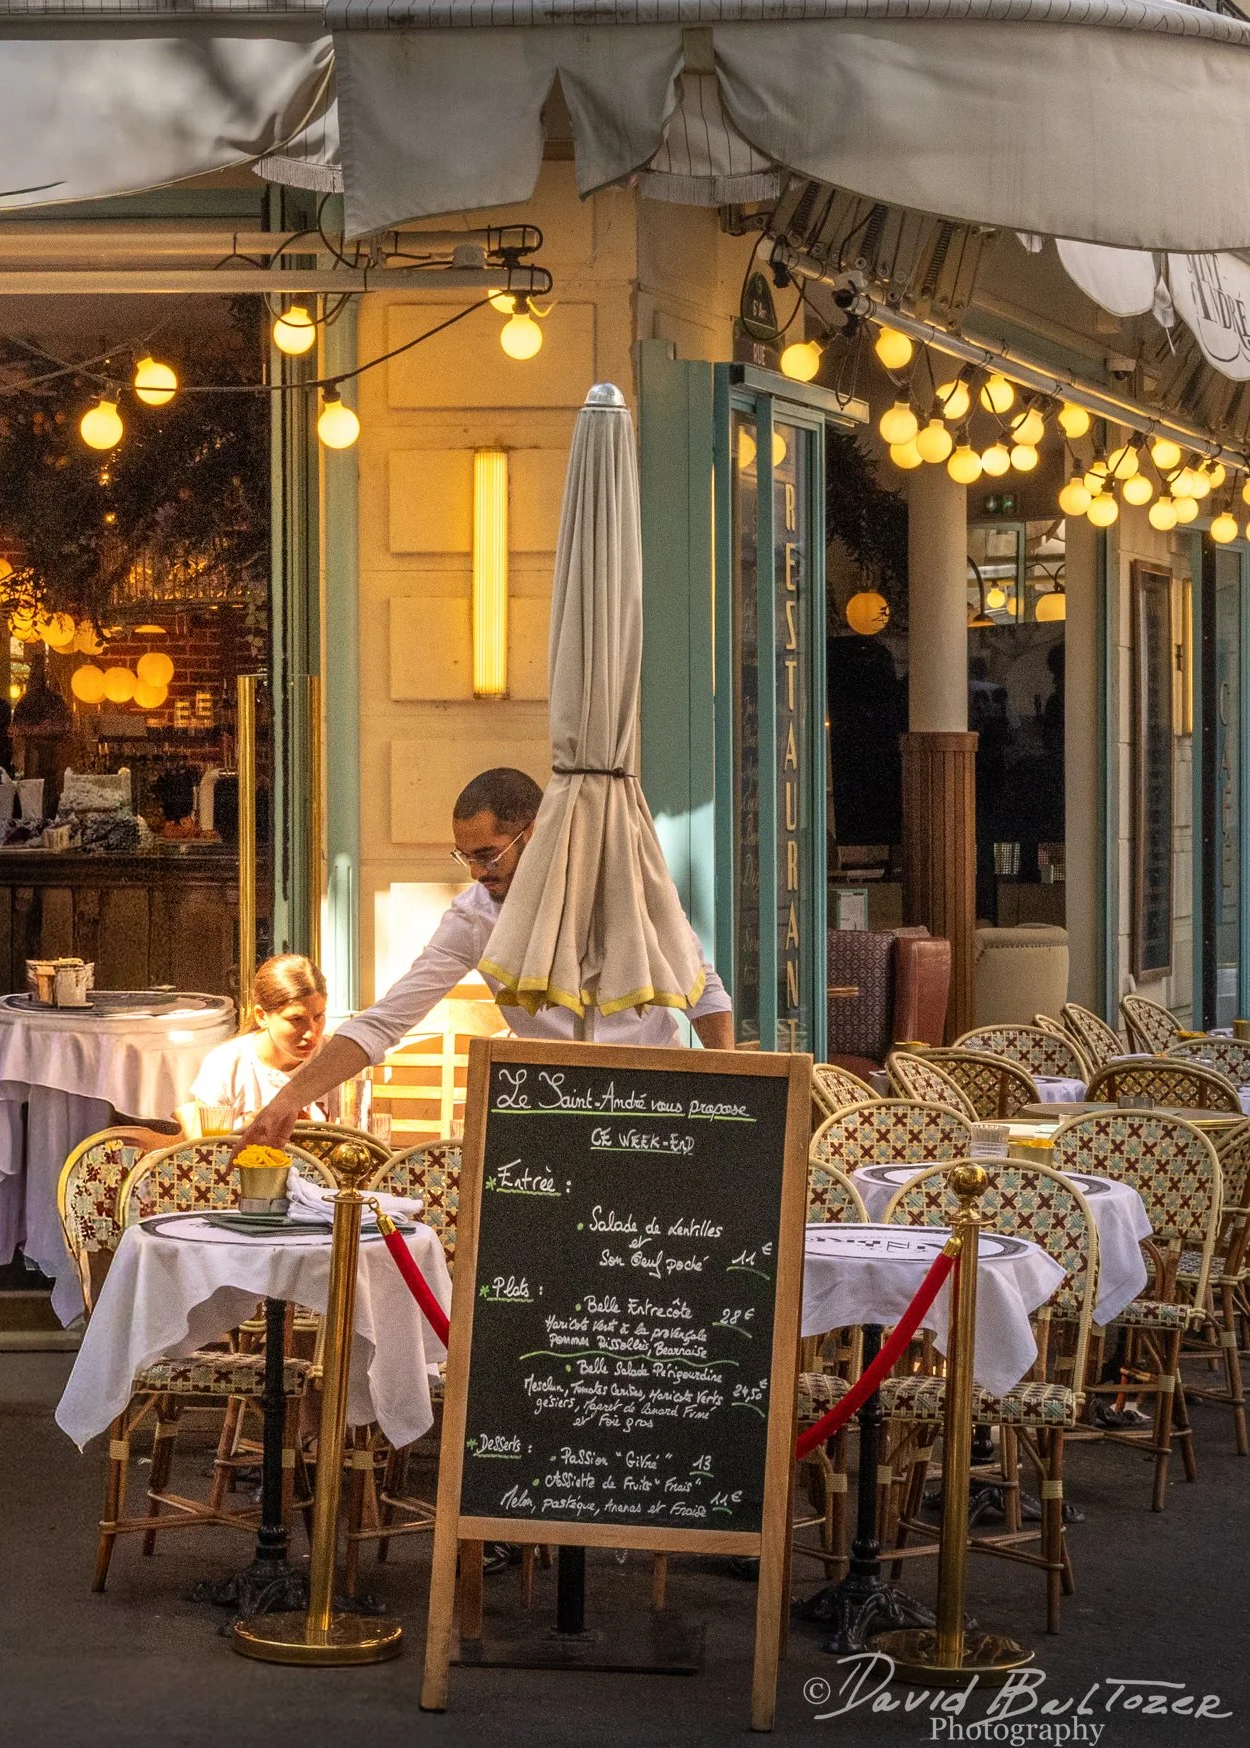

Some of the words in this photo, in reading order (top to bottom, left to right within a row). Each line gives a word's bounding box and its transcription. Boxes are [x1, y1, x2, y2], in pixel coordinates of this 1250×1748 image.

[784, 483, 800, 1053] RESTAURANT
[496, 1068, 532, 1109] Le
[651, 1100, 683, 1113] vous
[688, 1099, 750, 1122] propose
[591, 1127, 612, 1146] CE
[589, 1205, 638, 1233] Salade
[645, 1216, 661, 1235] de
[492, 1275, 530, 1298] Plats
[584, 1295, 621, 1314] Belle
[634, 1322, 650, 1336] la
[576, 1357, 609, 1375] Belle
[614, 1361, 650, 1376] Salade
[623, 1401, 636, 1413] de
[476, 1433, 522, 1454] Desserts
[560, 1446, 609, 1466] Passion
[692, 1454, 712, 1471] 13
[602, 1475, 617, 1490] de
